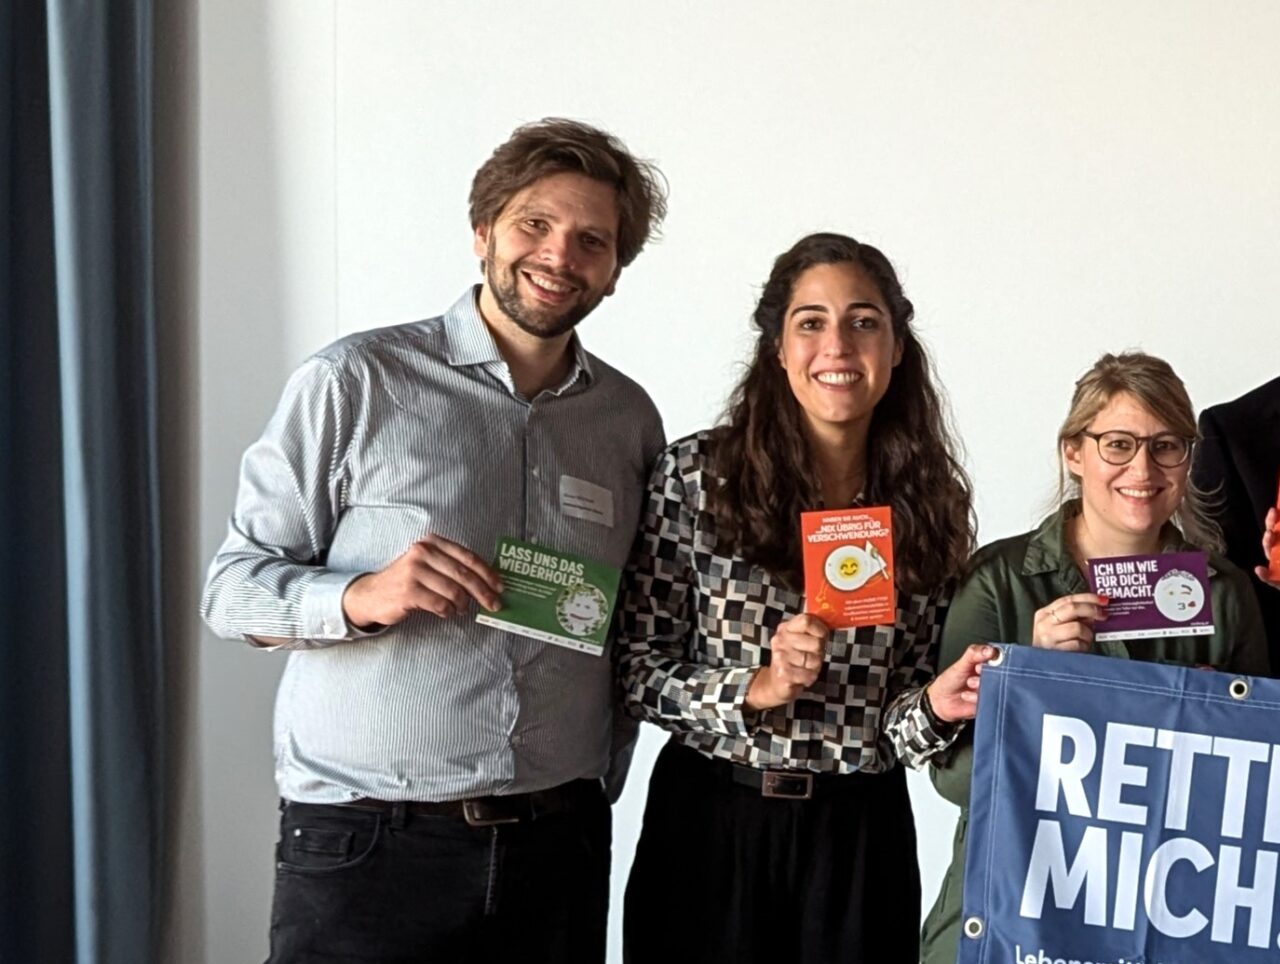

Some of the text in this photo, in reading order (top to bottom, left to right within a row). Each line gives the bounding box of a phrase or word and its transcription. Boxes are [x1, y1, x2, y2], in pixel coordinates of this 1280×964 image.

[500, 542, 585, 577] LASS UNS DAS
[1093, 559, 1158, 577] ICH BIN WIE
[1119, 573, 1147, 586] DICH
